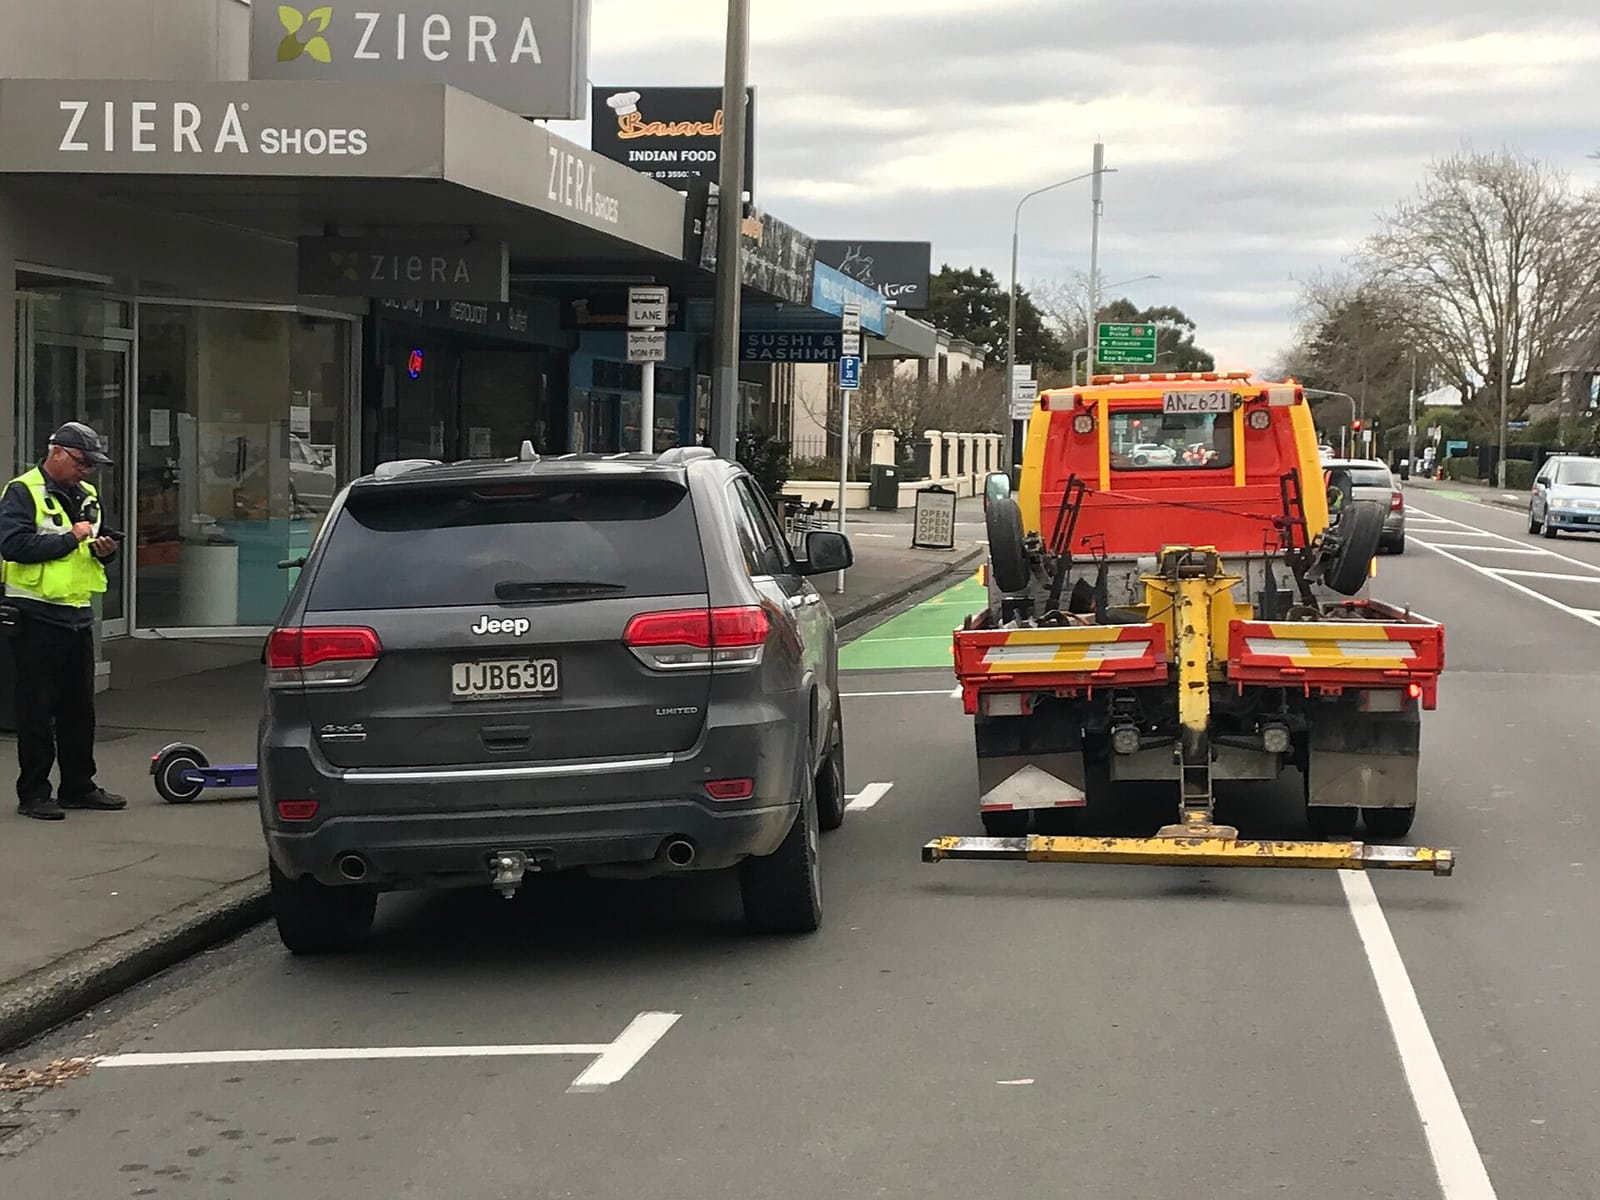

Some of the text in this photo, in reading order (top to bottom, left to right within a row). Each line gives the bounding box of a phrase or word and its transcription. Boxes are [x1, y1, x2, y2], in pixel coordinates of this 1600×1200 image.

[58, 101, 367, 155] ZIERA SHOES
[618, 109, 724, 139] Bawarch
[629, 151, 716, 161] INDIAN FOOD
[548, 146, 618, 223] ZIERA SHOES
[634, 311, 661, 320] LANE
[748, 334, 812, 346] SUSHI
[822, 335, 836, 346] &
[746, 348, 838, 360] SASHIMI
[846, 359, 853, 369] P
[921, 509, 949, 518] OPEN
[920, 518, 949, 526] OPEN
[920, 525, 948, 534] OPEN
[919, 533, 948, 541] OPEN
[472, 615, 530, 637] Jeep
[456, 663, 555, 691] JJB630
[655, 707, 698, 716] LIMITED
[320, 723, 365, 732] 4x4
